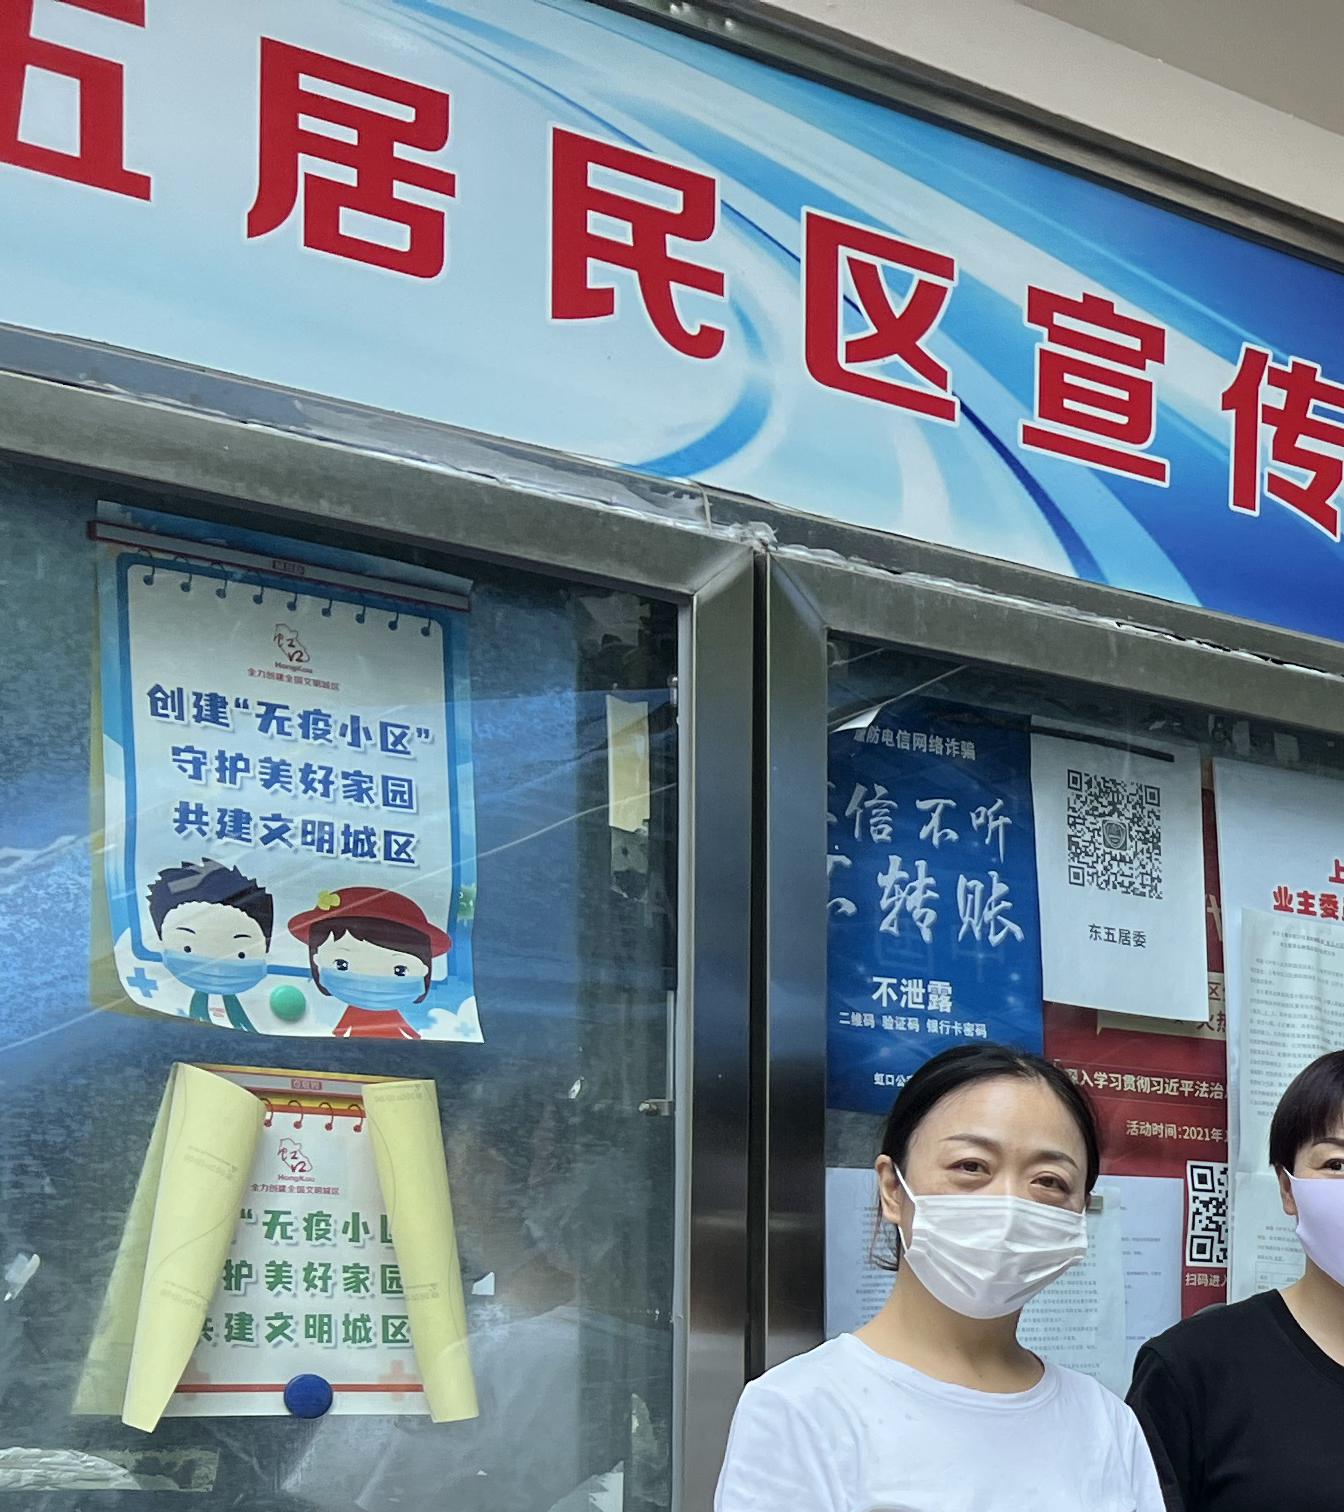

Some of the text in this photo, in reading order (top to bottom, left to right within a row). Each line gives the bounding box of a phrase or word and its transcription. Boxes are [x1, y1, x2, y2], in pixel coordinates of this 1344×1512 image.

[171, 745, 415, 811] 守护美好家园
[173, 801, 416, 864] 共建文明城区
[1088, 923, 1148, 950] 东五居委
[871, 976, 953, 1013] 不泄露
[881, 1015, 920, 1033] 验证码
[926, 1018, 988, 1039] 银行卡密码
